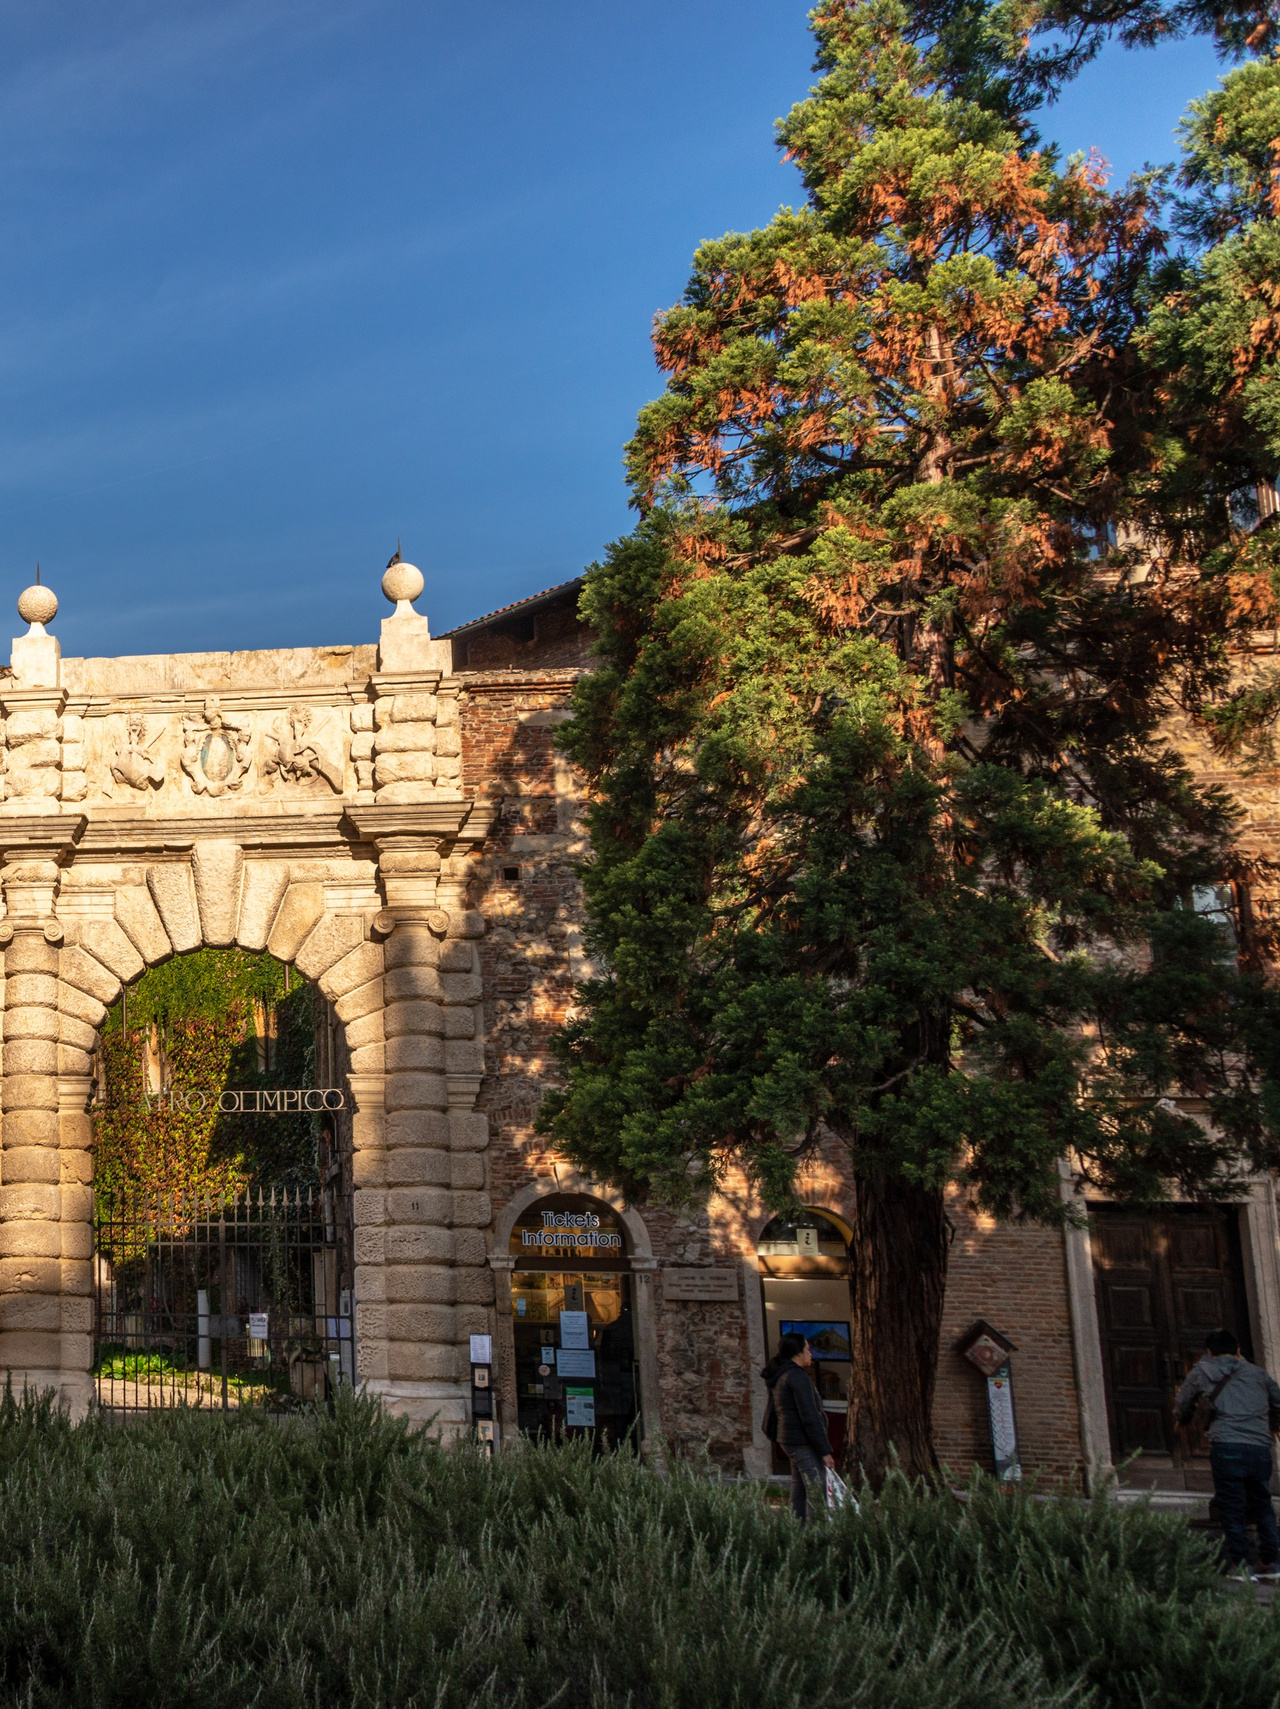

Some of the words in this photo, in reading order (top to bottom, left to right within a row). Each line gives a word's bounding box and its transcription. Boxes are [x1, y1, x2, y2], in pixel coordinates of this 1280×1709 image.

[218, 1088, 345, 1112] OLIMPICO
[541, 1211, 600, 1228] Tickets
[522, 1229, 621, 1248] Information
[639, 1274, 650, 1284] 12
